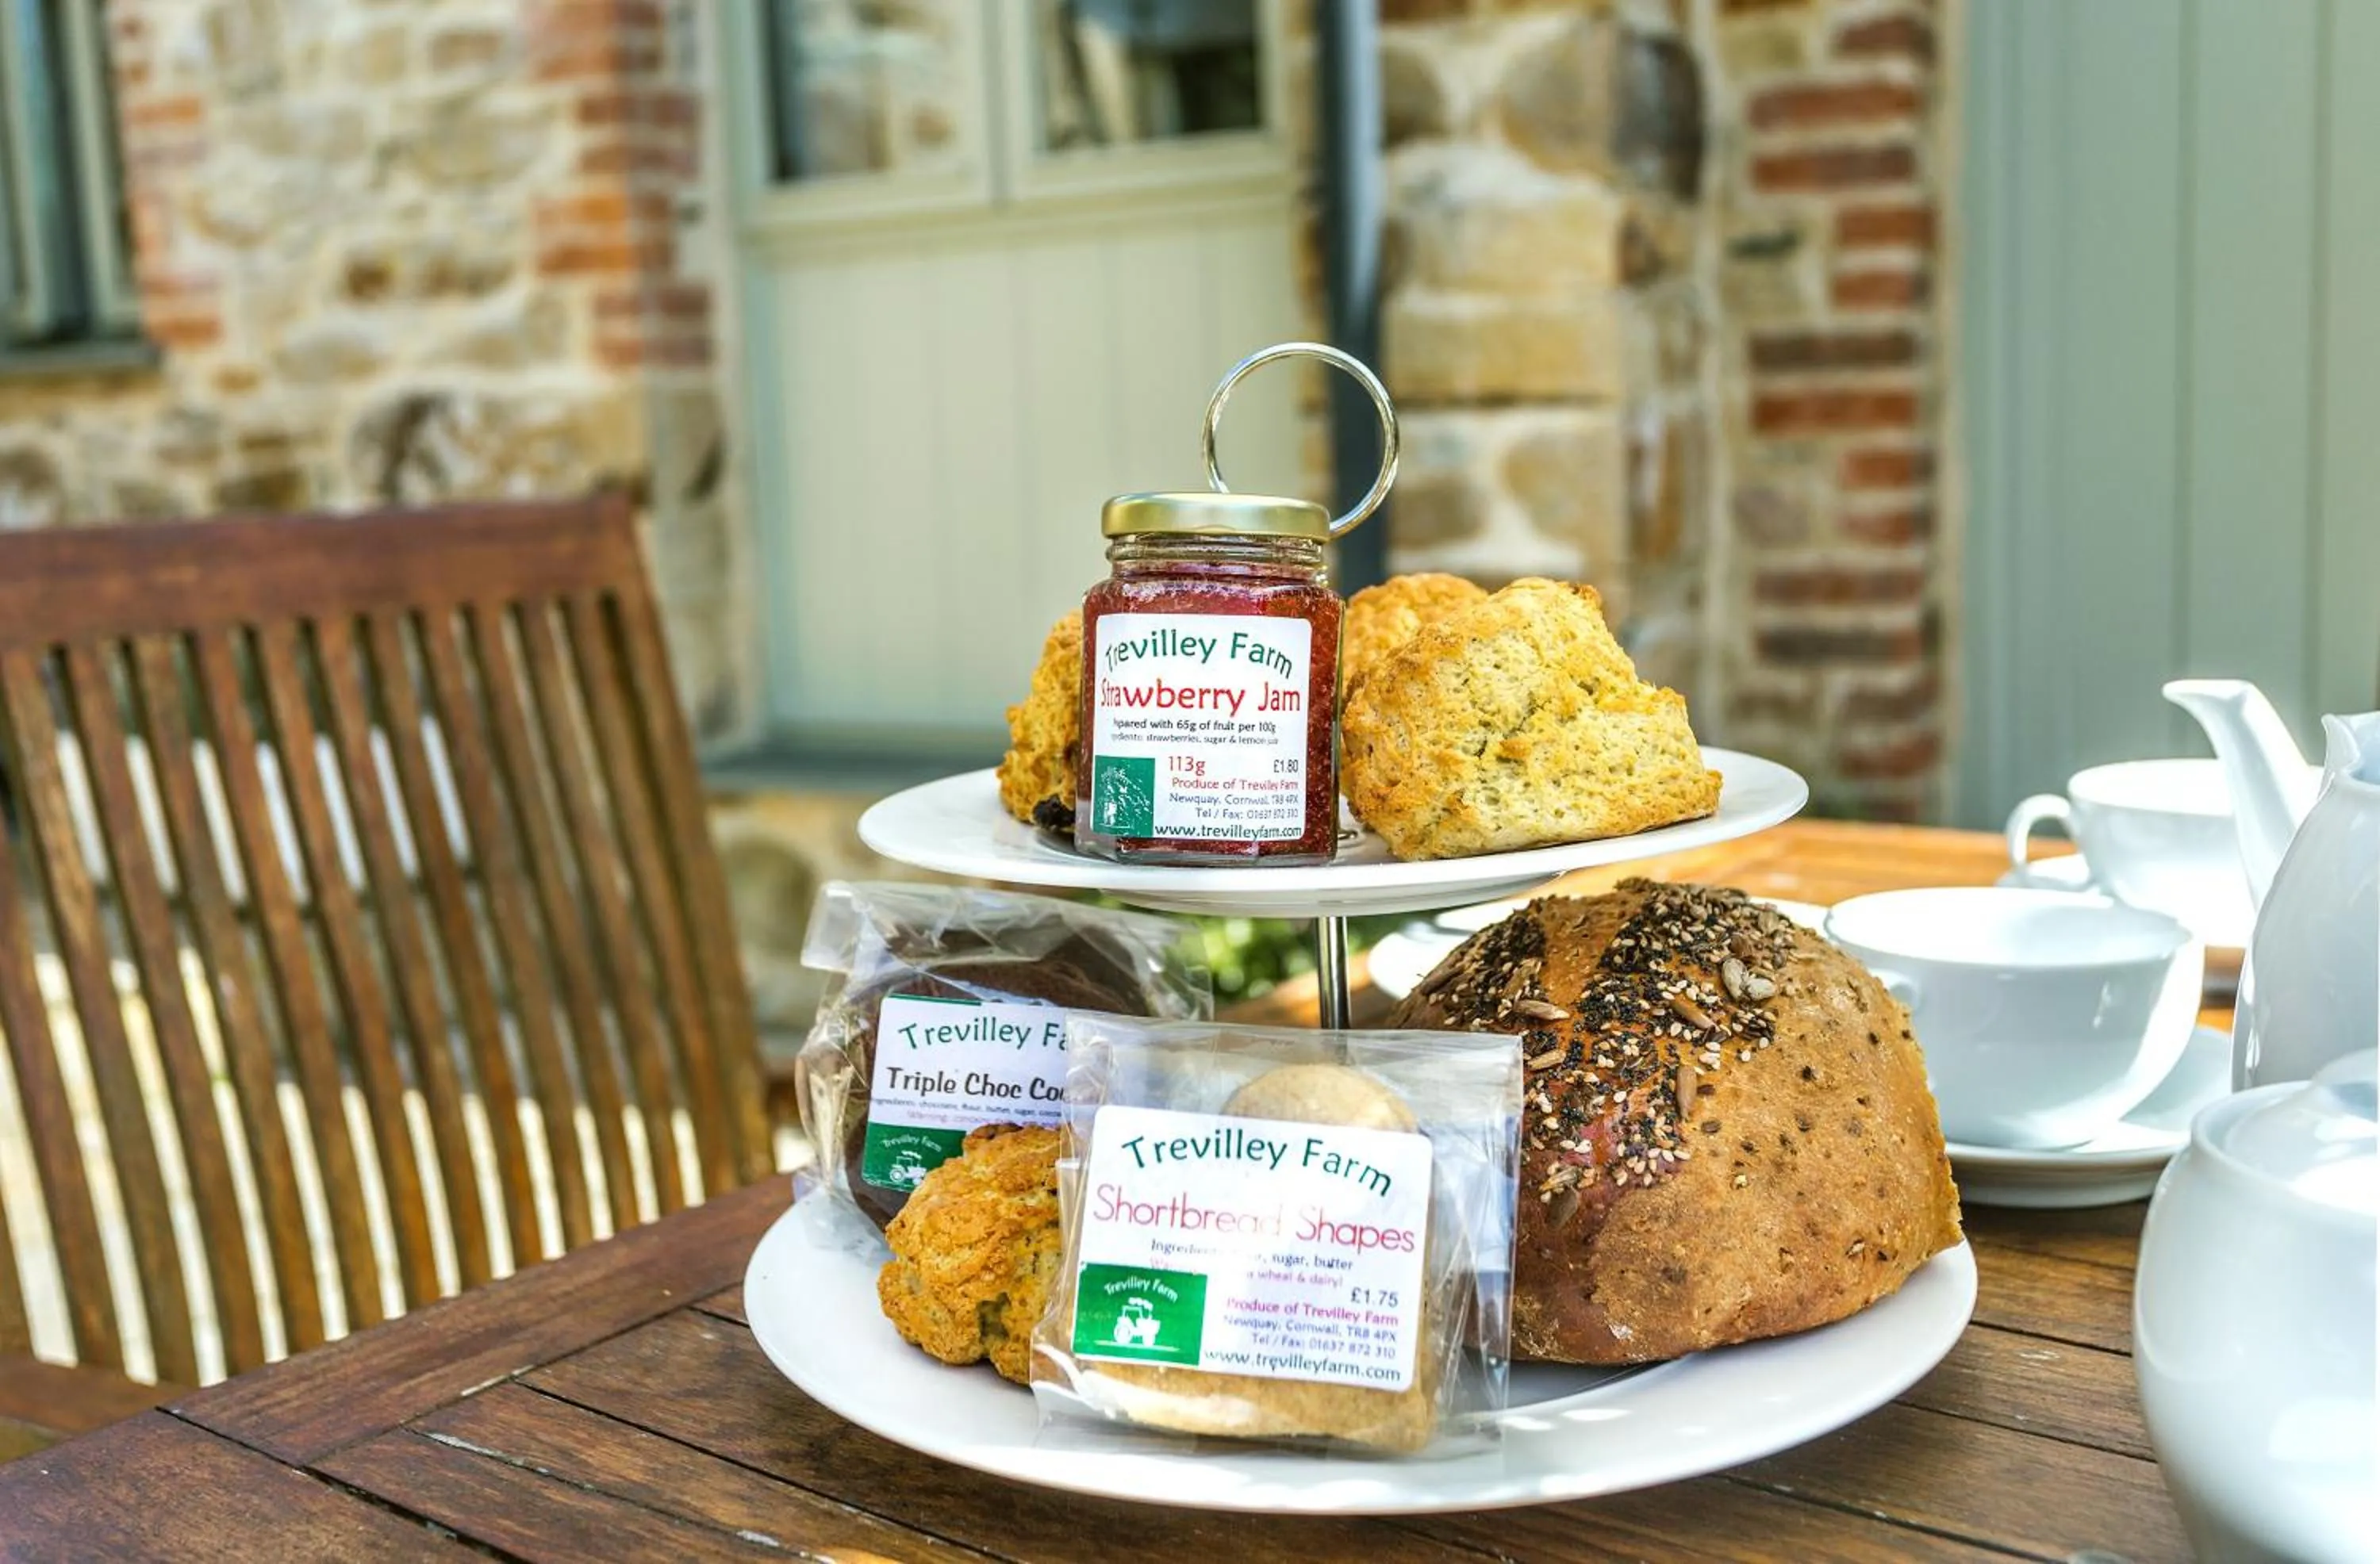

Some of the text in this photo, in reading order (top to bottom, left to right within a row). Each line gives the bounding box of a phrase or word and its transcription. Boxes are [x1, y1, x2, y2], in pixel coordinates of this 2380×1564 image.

[1106, 629, 1292, 679] Trevilley Farm
[1100, 678, 1300, 718] Strawberry Jam
[1150, 719, 1173, 729] with
[1177, 719, 1196, 731] 65g
[1199, 719, 1210, 730] of
[1214, 720, 1234, 730] fruit
[1238, 723, 1255, 733] per
[1203, 736, 1226, 745] sugar
[1169, 756, 1206, 776] 113g
[1273, 759, 1299, 772] £1.80
[1172, 777, 1219, 789] Produce
[1223, 778, 1236, 789] of
[1196, 807, 1211, 818] Tel
[1213, 808, 1219, 818] /
[1223, 808, 1243, 820] Fax:
[1155, 825, 1302, 841] www.trevilleyfarm.com
[897, 1017, 1031, 1050] Trevilley
[886, 1067, 957, 1097] Triple
[965, 1072, 1023, 1098] Choc
[1121, 1129, 1392, 1198] Trevilley Farm
[1093, 1183, 1415, 1254] Shortbread Shapes
[1314, 1255, 1353, 1271] butter
[1257, 1271, 1293, 1282] wheat
[1297, 1272, 1305, 1283] &
[1104, 1275, 1179, 1304] Trevilley Farm
[1351, 1286, 1399, 1308] £1.75
[1226, 1297, 1399, 1327] Produce of Trevilley Farm
[1252, 1332, 1269, 1345] Tel
[1273, 1333, 1280, 1346] /
[1375, 1346, 1395, 1359] 310
[1374, 1331, 1396, 1343] 4PX
[1205, 1349, 1401, 1382] www.trevilleyfarm.com
